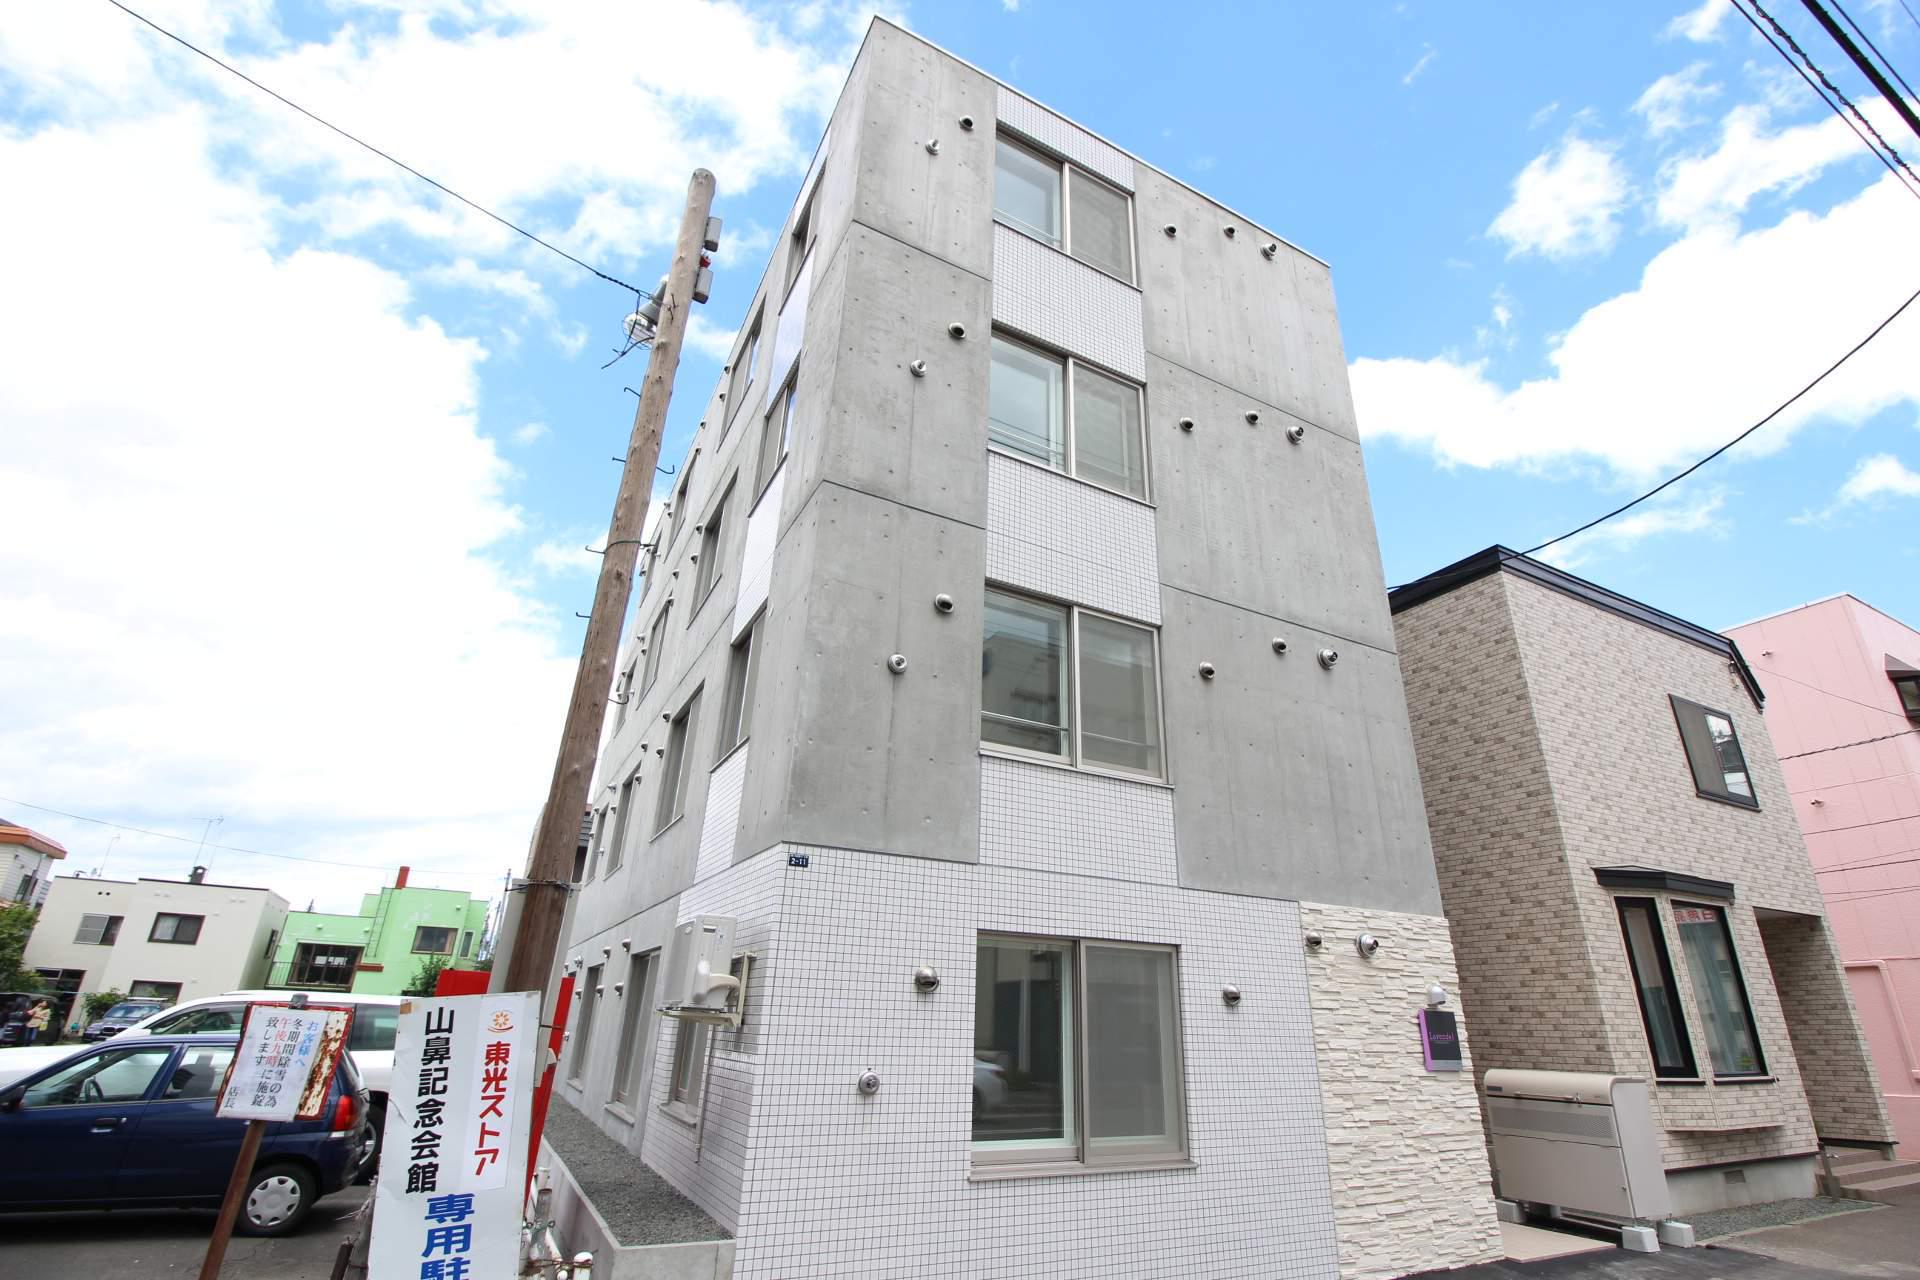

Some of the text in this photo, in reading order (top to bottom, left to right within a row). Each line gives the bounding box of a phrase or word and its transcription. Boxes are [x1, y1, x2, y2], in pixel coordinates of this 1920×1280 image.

[255, 1016, 280, 1066] 致します
[295, 1020, 319, 1067] お客様へ
[224, 1086, 240, 1109] 店長
[406, 1006, 455, 1194] 山鼻記念会館
[474, 1040, 511, 1176] 東光ストア
